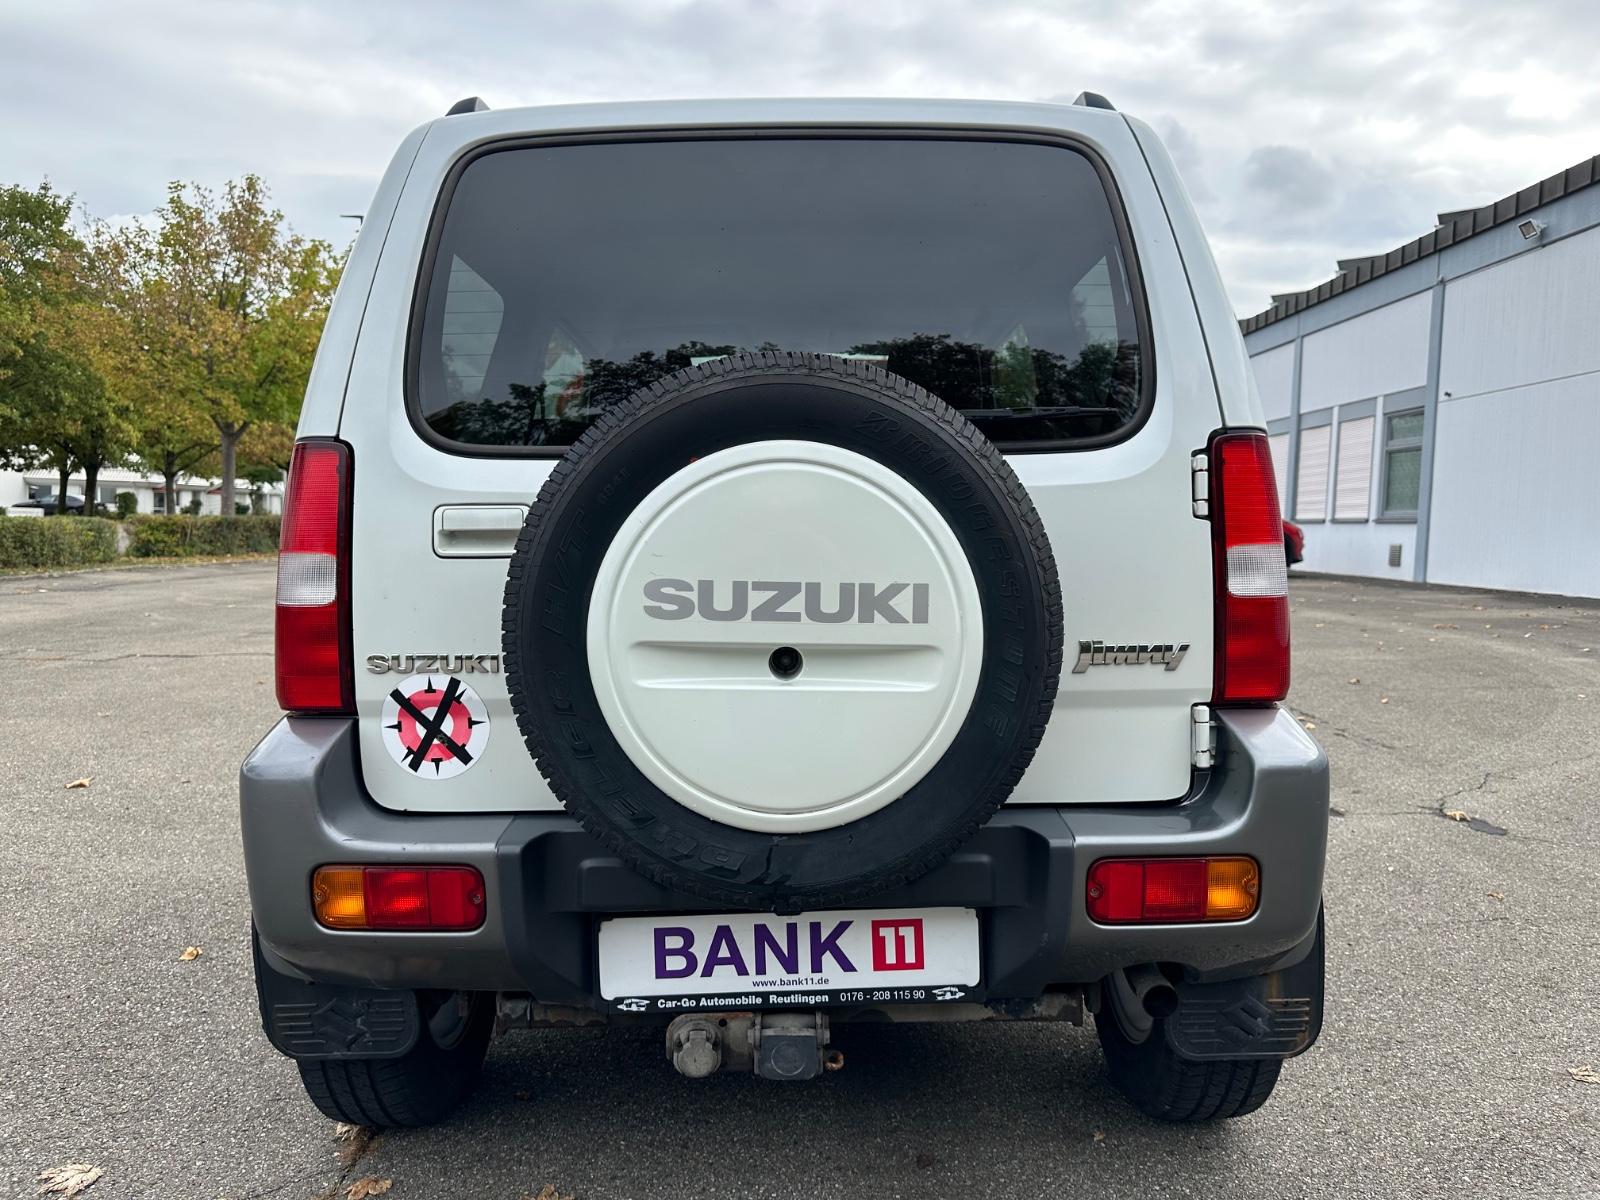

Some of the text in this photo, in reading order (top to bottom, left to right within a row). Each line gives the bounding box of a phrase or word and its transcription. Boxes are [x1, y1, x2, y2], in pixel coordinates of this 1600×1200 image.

[643, 578, 930, 624] SUZUKI
[366, 653, 500, 675] SUZUKI
[653, 920, 917, 979] BANK 11
[752, 977, 830, 988] www.bank11.de
[657, 998, 697, 1009] Car-Go
[699, 996, 763, 1008] Automobile
[769, 993, 830, 1006] Reutlingen
[840, 991, 864, 1002] 0176
[872, 990, 891, 1001] 208
